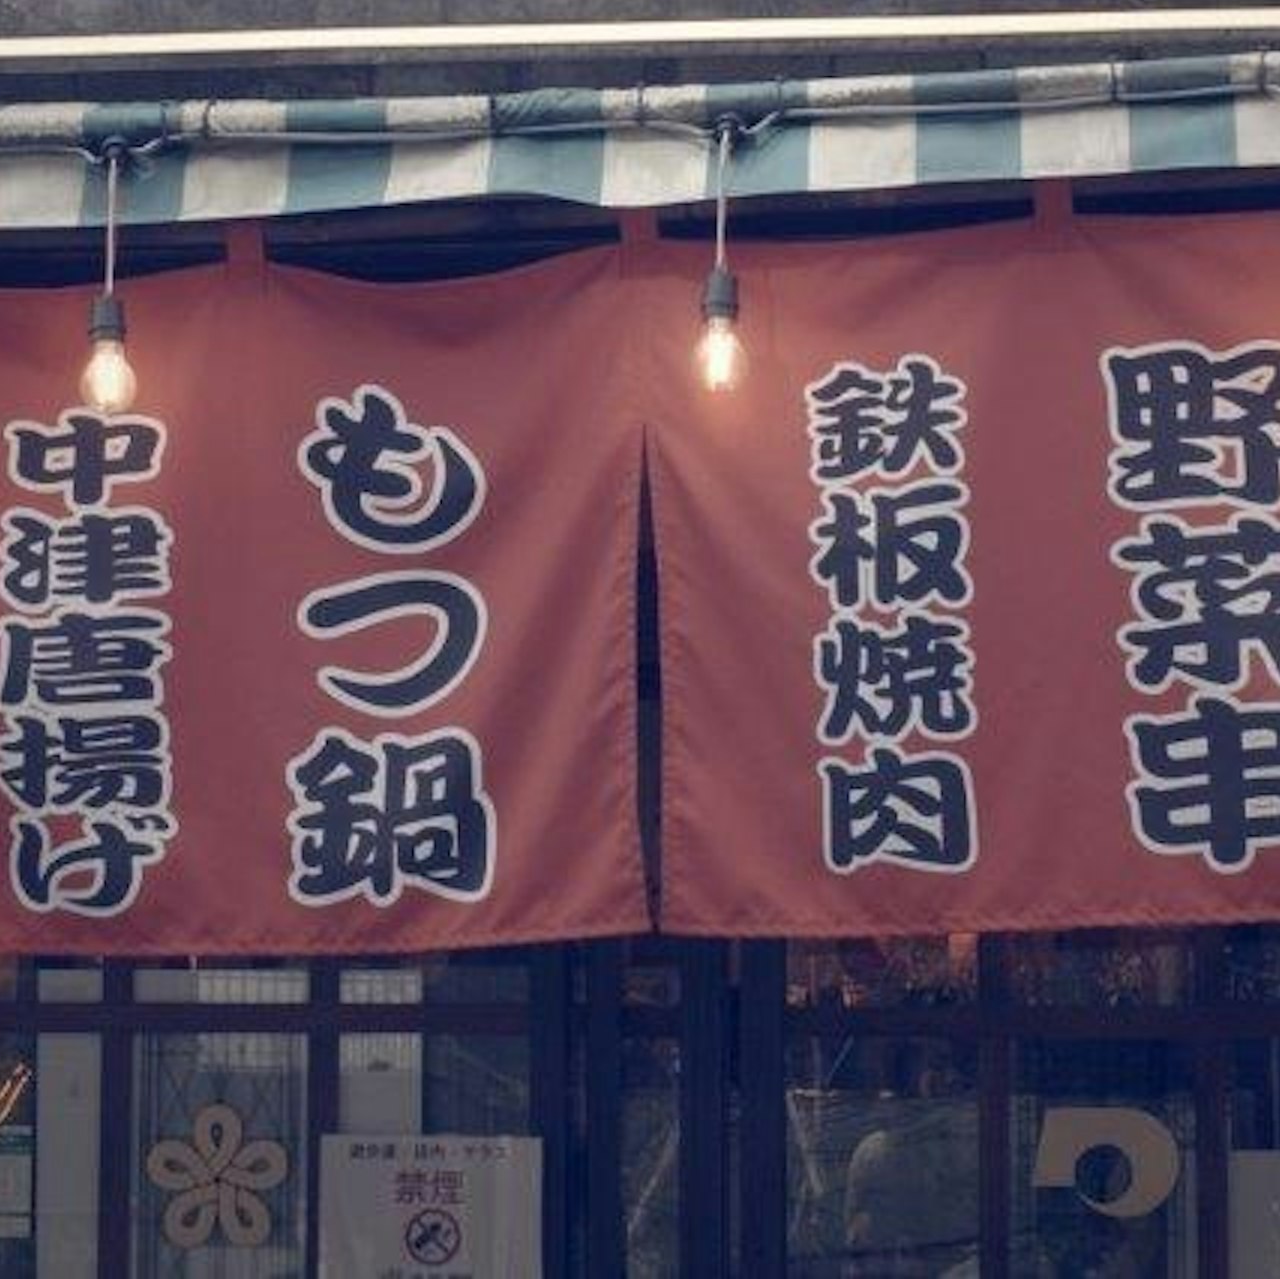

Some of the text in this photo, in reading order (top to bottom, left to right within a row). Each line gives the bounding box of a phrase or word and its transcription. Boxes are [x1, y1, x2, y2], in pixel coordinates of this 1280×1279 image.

[287, 384, 496, 905] もつ鍋
[806, 354, 977, 874] 鉄板焼肉
[395, 1169, 465, 1205] 禁煙
